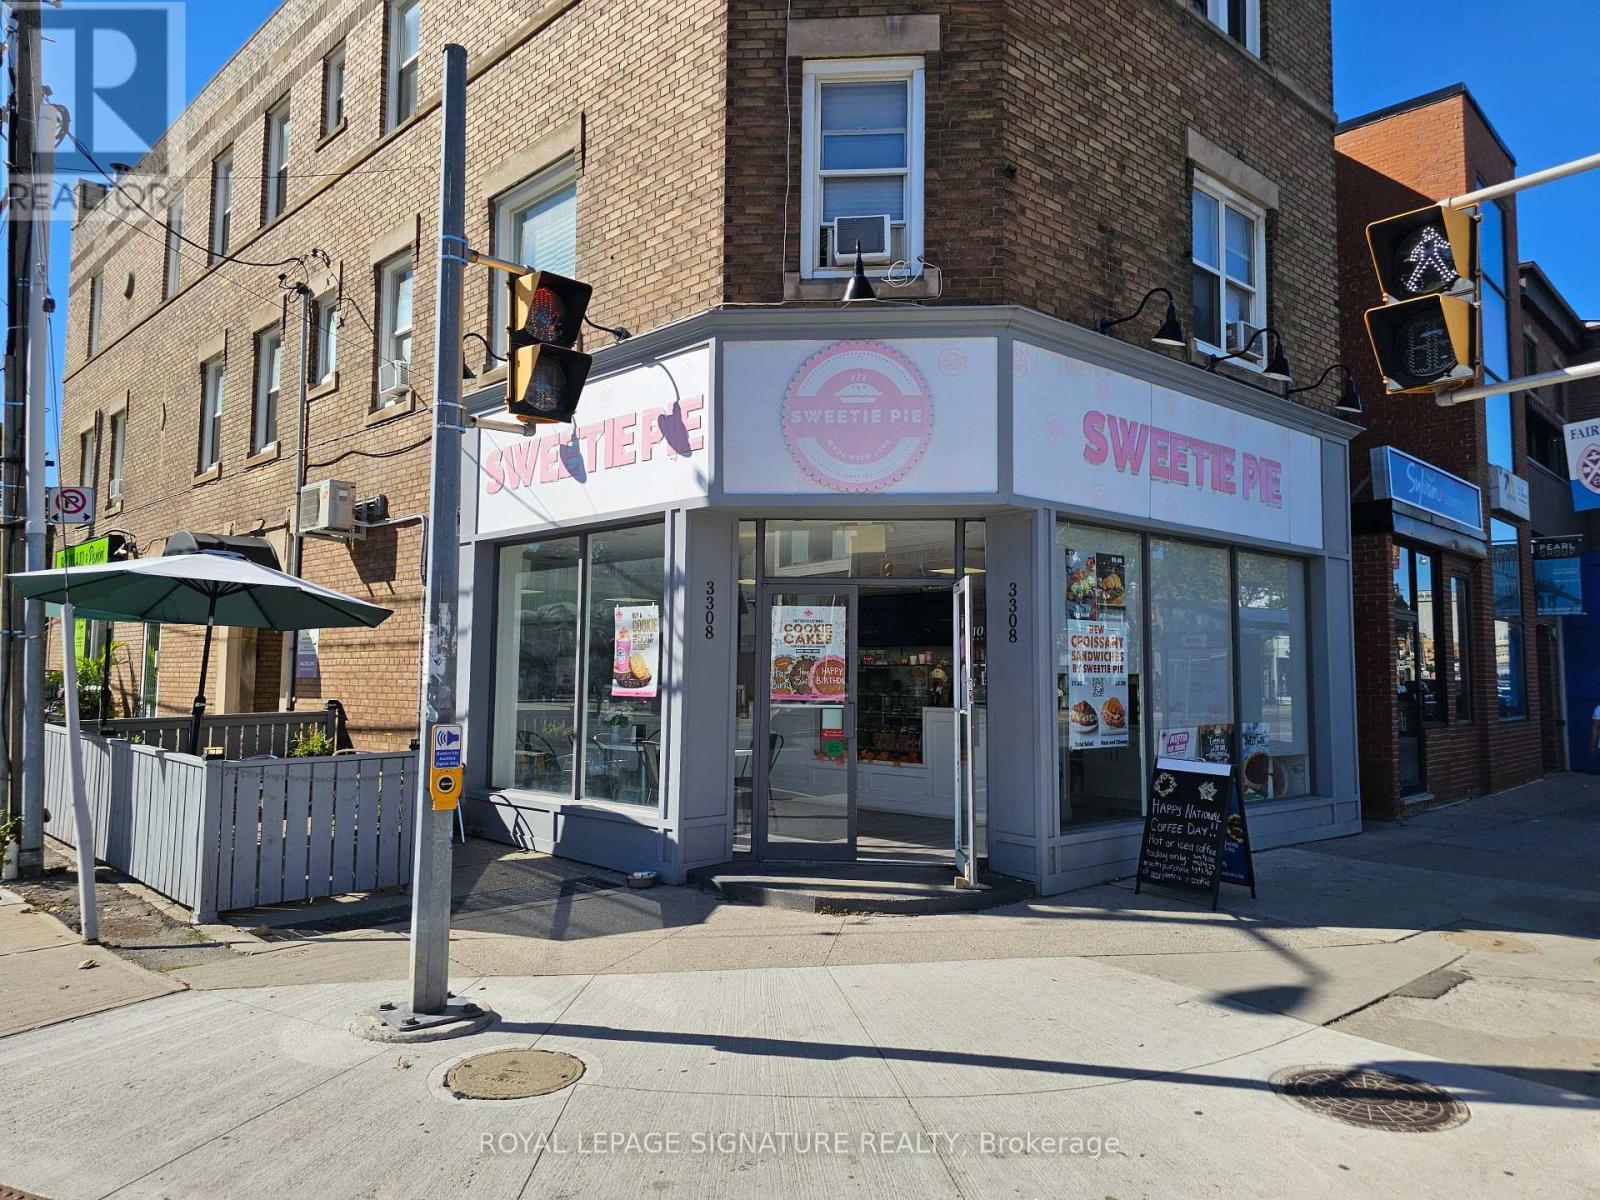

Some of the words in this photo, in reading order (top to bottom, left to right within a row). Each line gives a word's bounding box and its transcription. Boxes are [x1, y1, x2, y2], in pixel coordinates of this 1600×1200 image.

[790, 408, 883, 424] SWEETIE
[890, 408, 923, 424] PIE
[486, 411, 637, 495] SWEETIE
[641, 394, 704, 462] PIE
[1083, 410, 1236, 496] SWEETIE
[1242, 451, 1282, 509] PIE
[1539, 542, 1577, 551] PEARL
[705, 580, 715, 640] 3308
[1008, 582, 1018, 643] 3308
[632, 619, 658, 632] COOKIE
[783, 623, 833, 634] COOKIE
[1088, 624, 1105, 635] NEW
[783, 633, 833, 645] CAKES
[1071, 634, 1124, 649] CROISSANT
[1071, 650, 1124, 662] SANDWICHES
[821, 667, 844, 676] HAPPY
[1083, 665, 1111, 673] SWEETIE
[1112, 665, 1124, 673] PIE
[1185, 804, 1222, 823] NATIONAL
[1150, 817, 1184, 834] COFFEE
